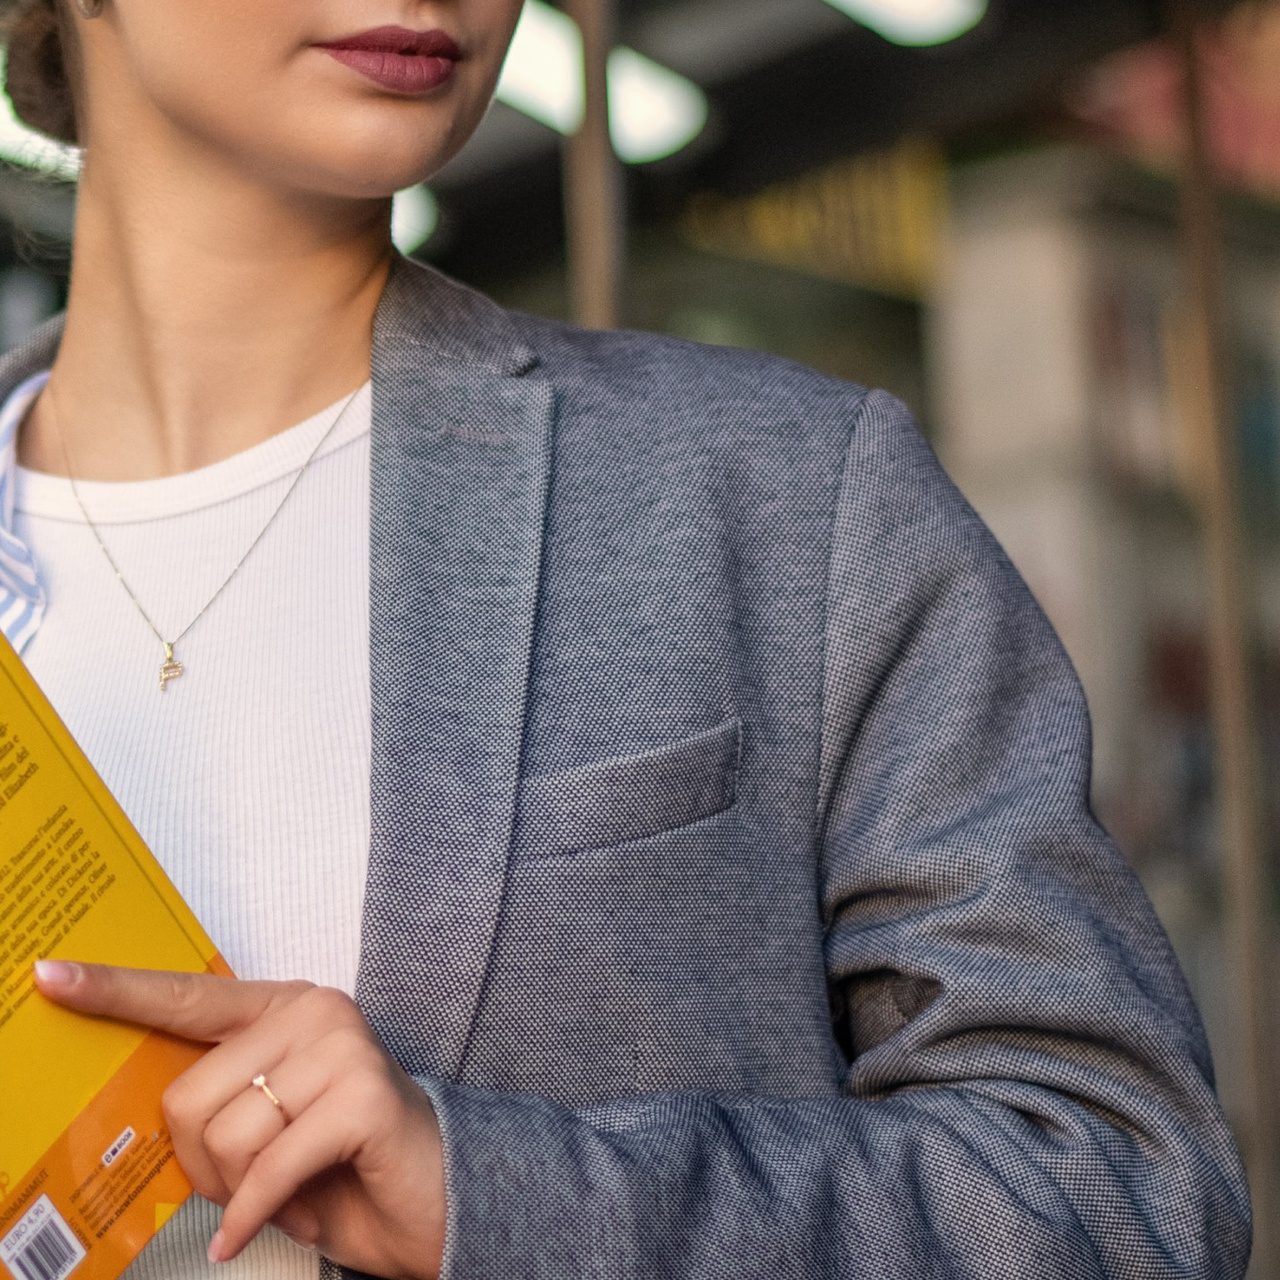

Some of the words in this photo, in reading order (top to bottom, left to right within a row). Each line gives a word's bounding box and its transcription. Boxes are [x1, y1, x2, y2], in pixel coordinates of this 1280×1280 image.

[116, 1129, 132, 1149] BOOK
[2, 1220, 29, 1252] EURO
[25, 1201, 46, 1227] 4,90
